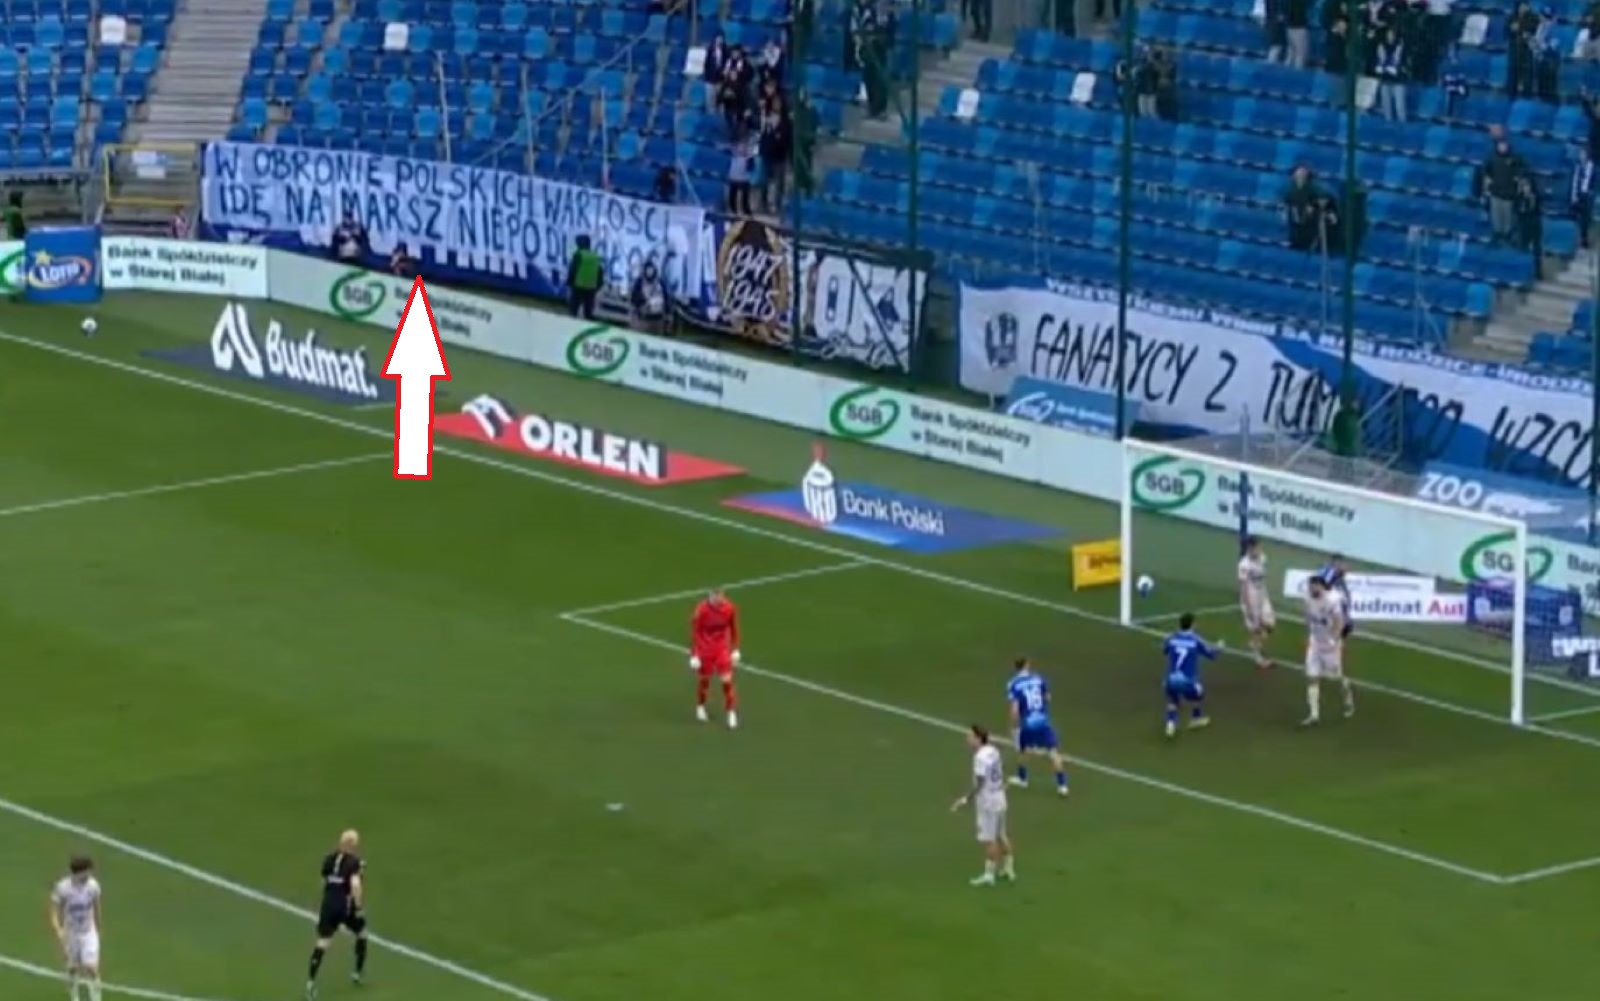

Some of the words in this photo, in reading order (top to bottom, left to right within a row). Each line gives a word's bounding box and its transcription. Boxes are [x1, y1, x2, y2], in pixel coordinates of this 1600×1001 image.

[214, 144, 238, 179] W
[253, 147, 384, 187] OBRONIE
[395, 160, 534, 215] POLSKICH
[219, 183, 272, 226] IDĘ
[286, 185, 326, 225] NA
[341, 190, 443, 241] MARSZ
[846, 402, 883, 427] SGB
[519, 413, 660, 480] ORLEN
[1144, 473, 1185, 497] SGB
[1418, 471, 1483, 507] ZOO
[842, 488, 890, 521] Bank
[887, 500, 945, 537] Polski
[1175, 646, 1188, 670] 7
